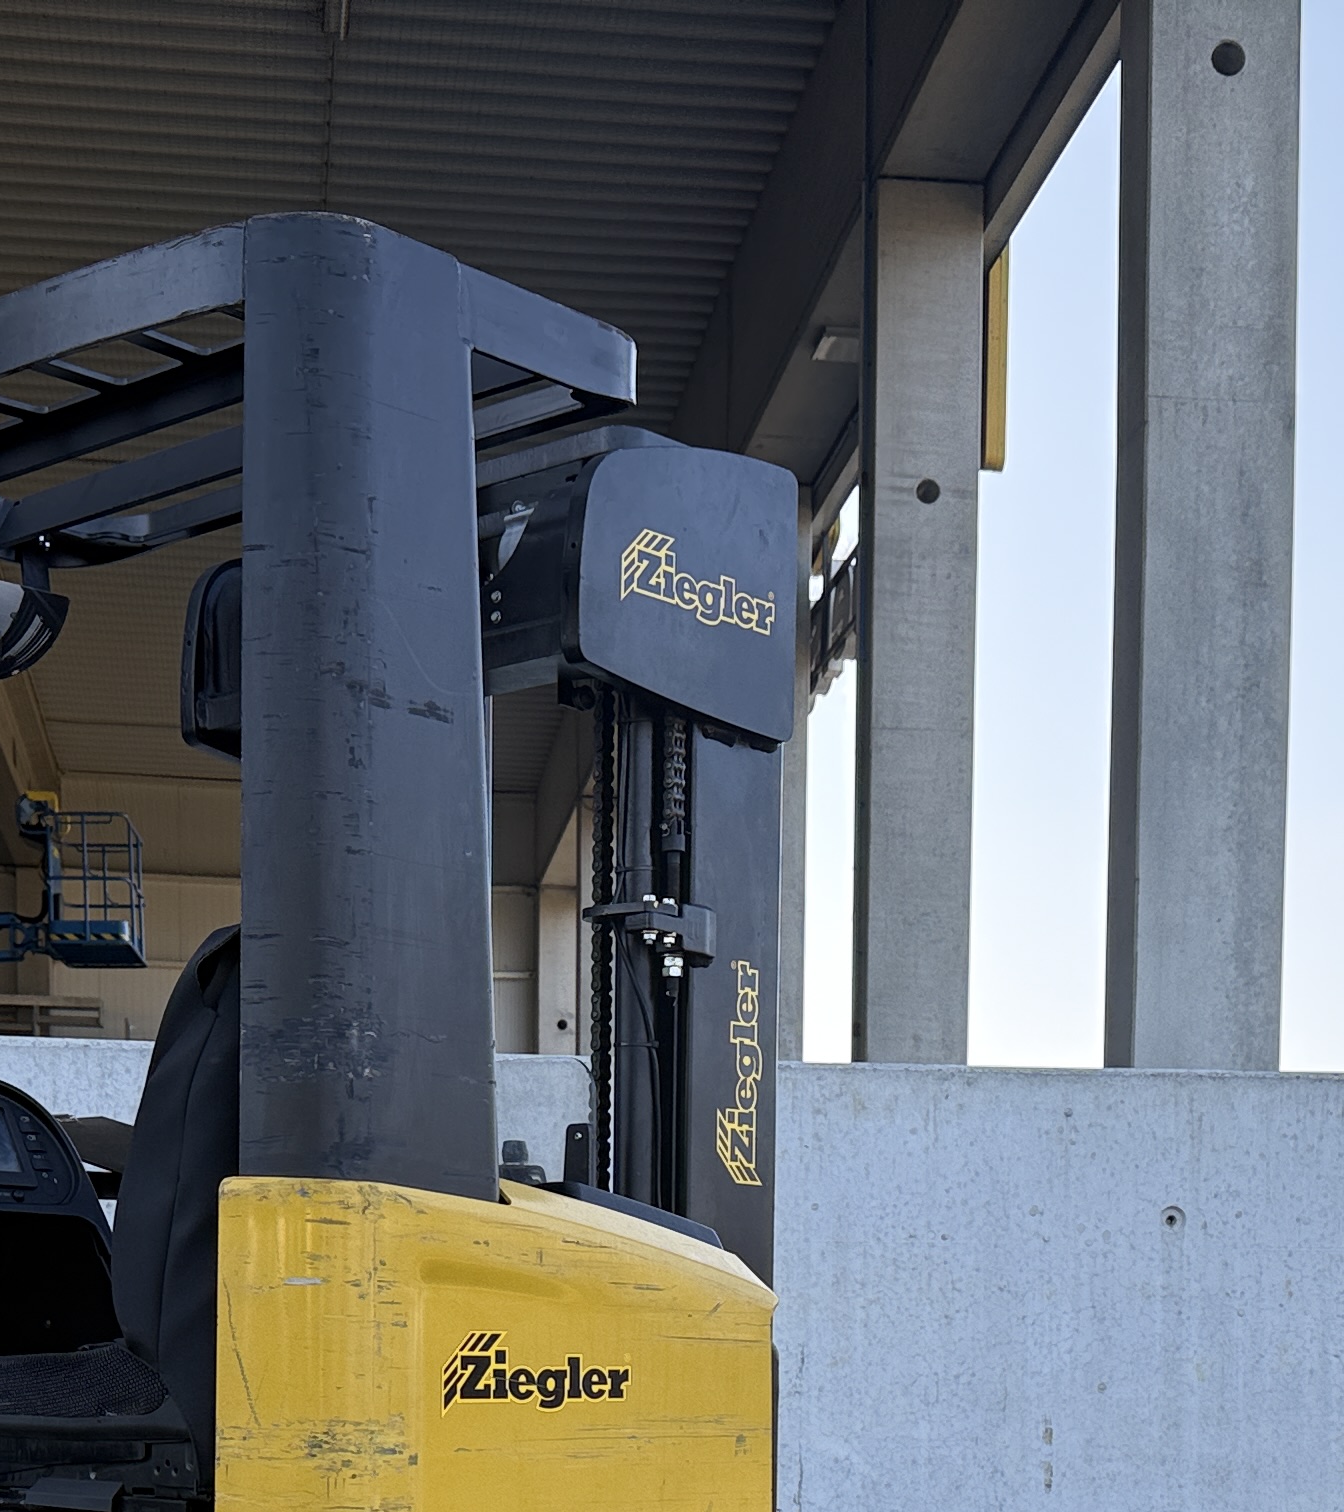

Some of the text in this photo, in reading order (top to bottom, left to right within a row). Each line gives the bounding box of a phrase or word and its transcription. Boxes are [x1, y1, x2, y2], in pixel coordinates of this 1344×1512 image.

[633, 547, 775, 636] Ziegler
[725, 961, 762, 1168] Ziegler
[456, 1347, 631, 1412] Ziegler
